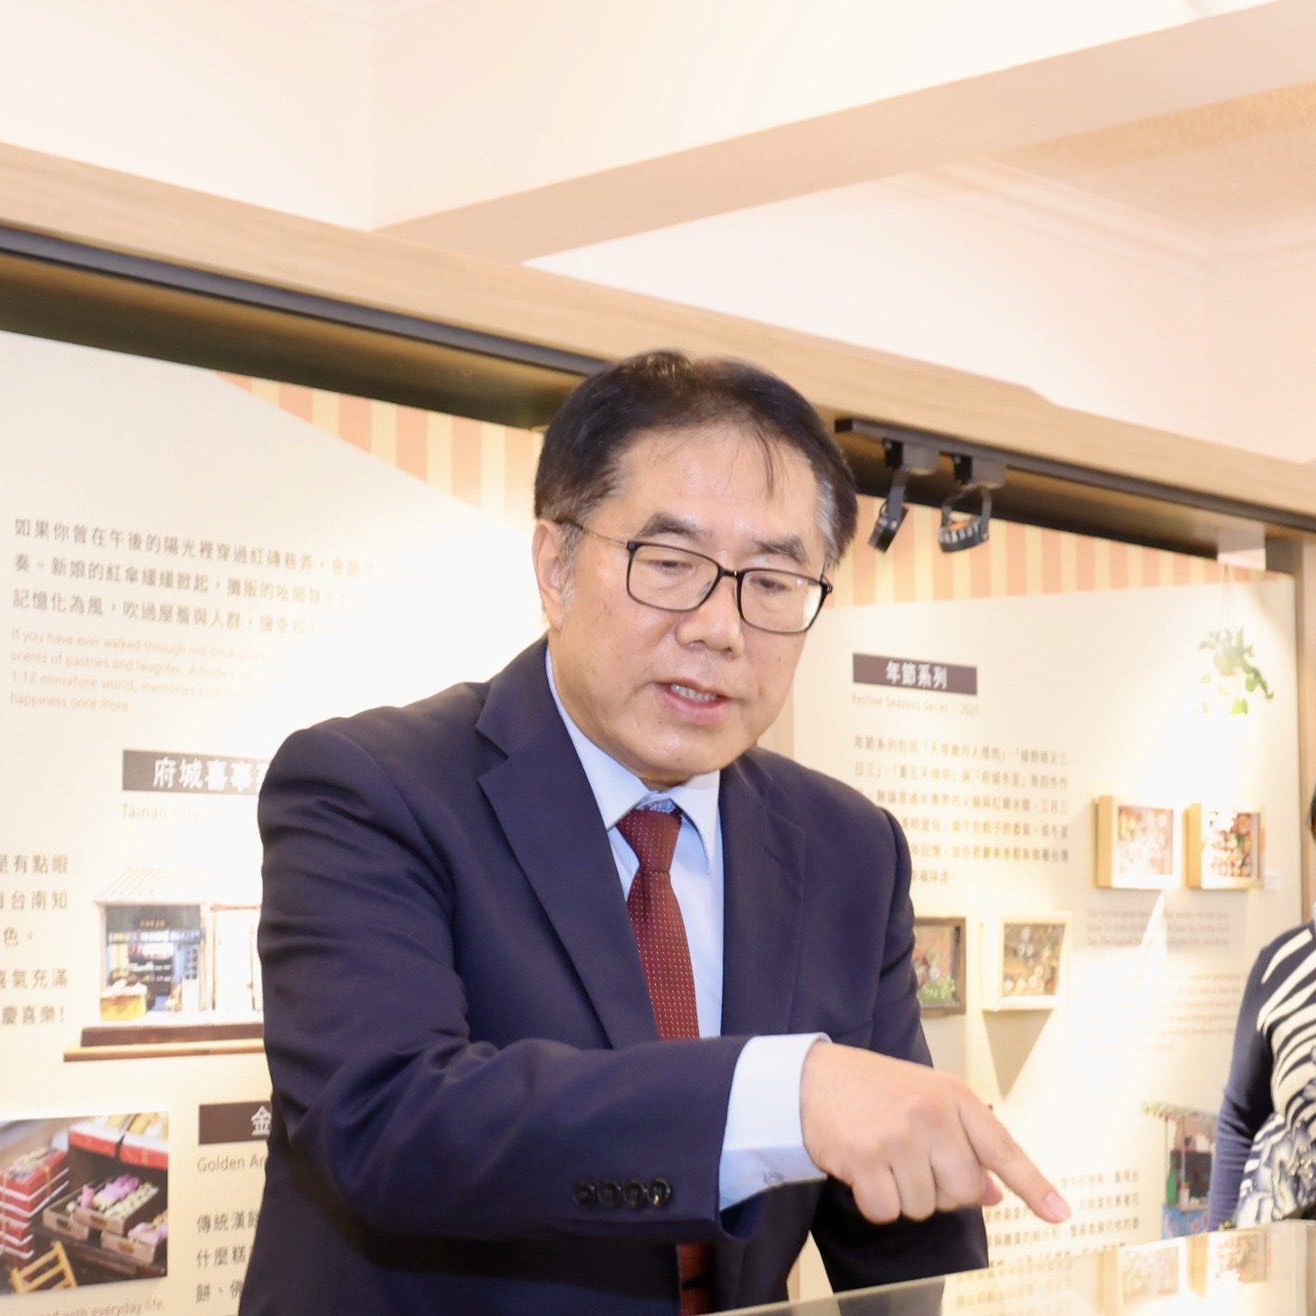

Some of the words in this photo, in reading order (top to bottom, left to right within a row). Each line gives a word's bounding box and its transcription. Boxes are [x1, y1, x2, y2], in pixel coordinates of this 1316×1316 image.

[22, 631, 44, 645] you
[47, 629, 73, 644] have
[50, 650, 63, 665] of
[112, 659, 133, 671] and
[40, 674, 97, 688] miniature
[885, 659, 948, 690] 年節系列
[9, 688, 67, 709] happiness
[197, 1154, 245, 1174] Golden
